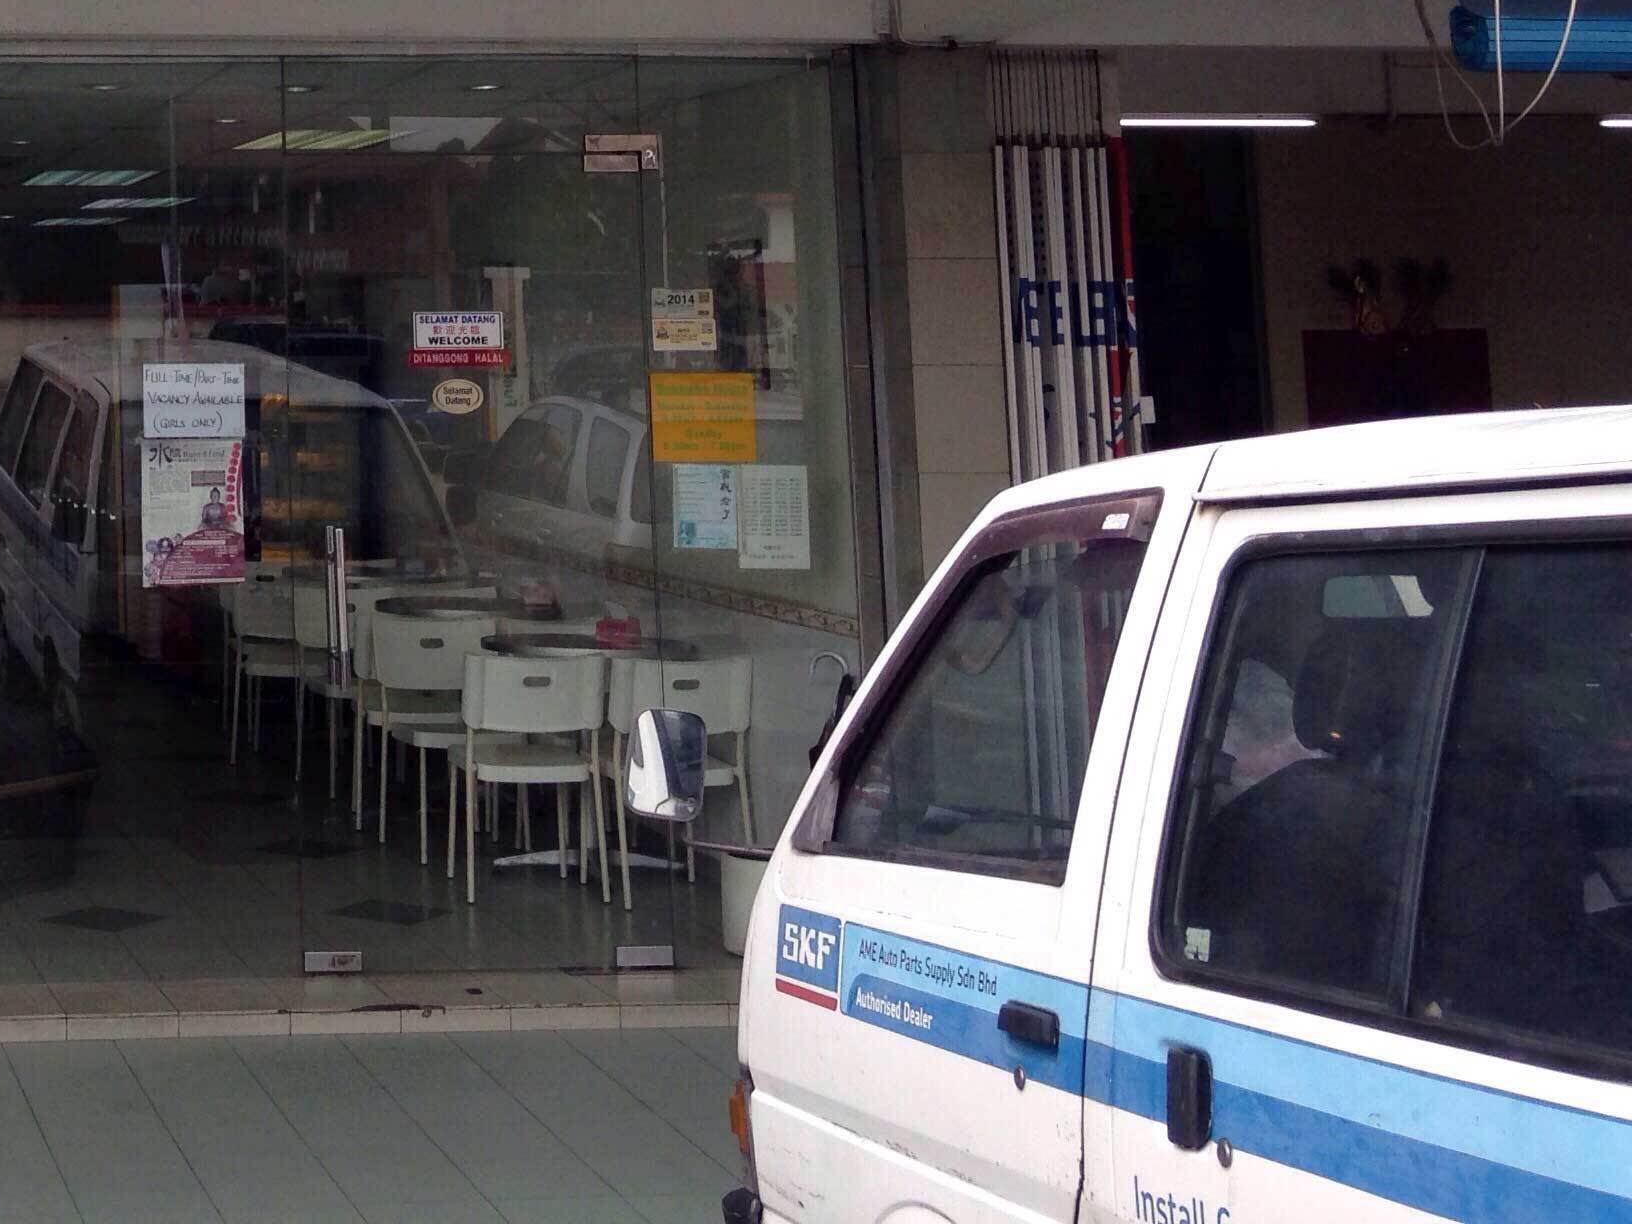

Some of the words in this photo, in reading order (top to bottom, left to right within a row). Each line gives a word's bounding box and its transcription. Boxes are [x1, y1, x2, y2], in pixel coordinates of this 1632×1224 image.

[667, 294, 695, 305] 2014
[419, 315, 459, 324] SELAMAT
[461, 315, 496, 324] DATANG
[428, 336, 489, 345] WELCOME
[474, 352, 504, 364] HALAL
[144, 368, 168, 383] FULL
[443, 386, 473, 396] Selamat
[147, 391, 191, 406] VACANCY
[193, 391, 244, 406] AVAILABLE
[445, 396, 471, 406] Datang
[782, 922, 836, 970] SKF
[858, 938, 877, 959] AME
[878, 943, 898, 964] Auto
[900, 949, 922, 975] Parts
[924, 956, 955, 988] Supply
[957, 966, 975, 990] Sdn
[978, 971, 998, 996] Bhd
[855, 986, 901, 1020] Authorised
[903, 1003, 934, 1030] Dealer
